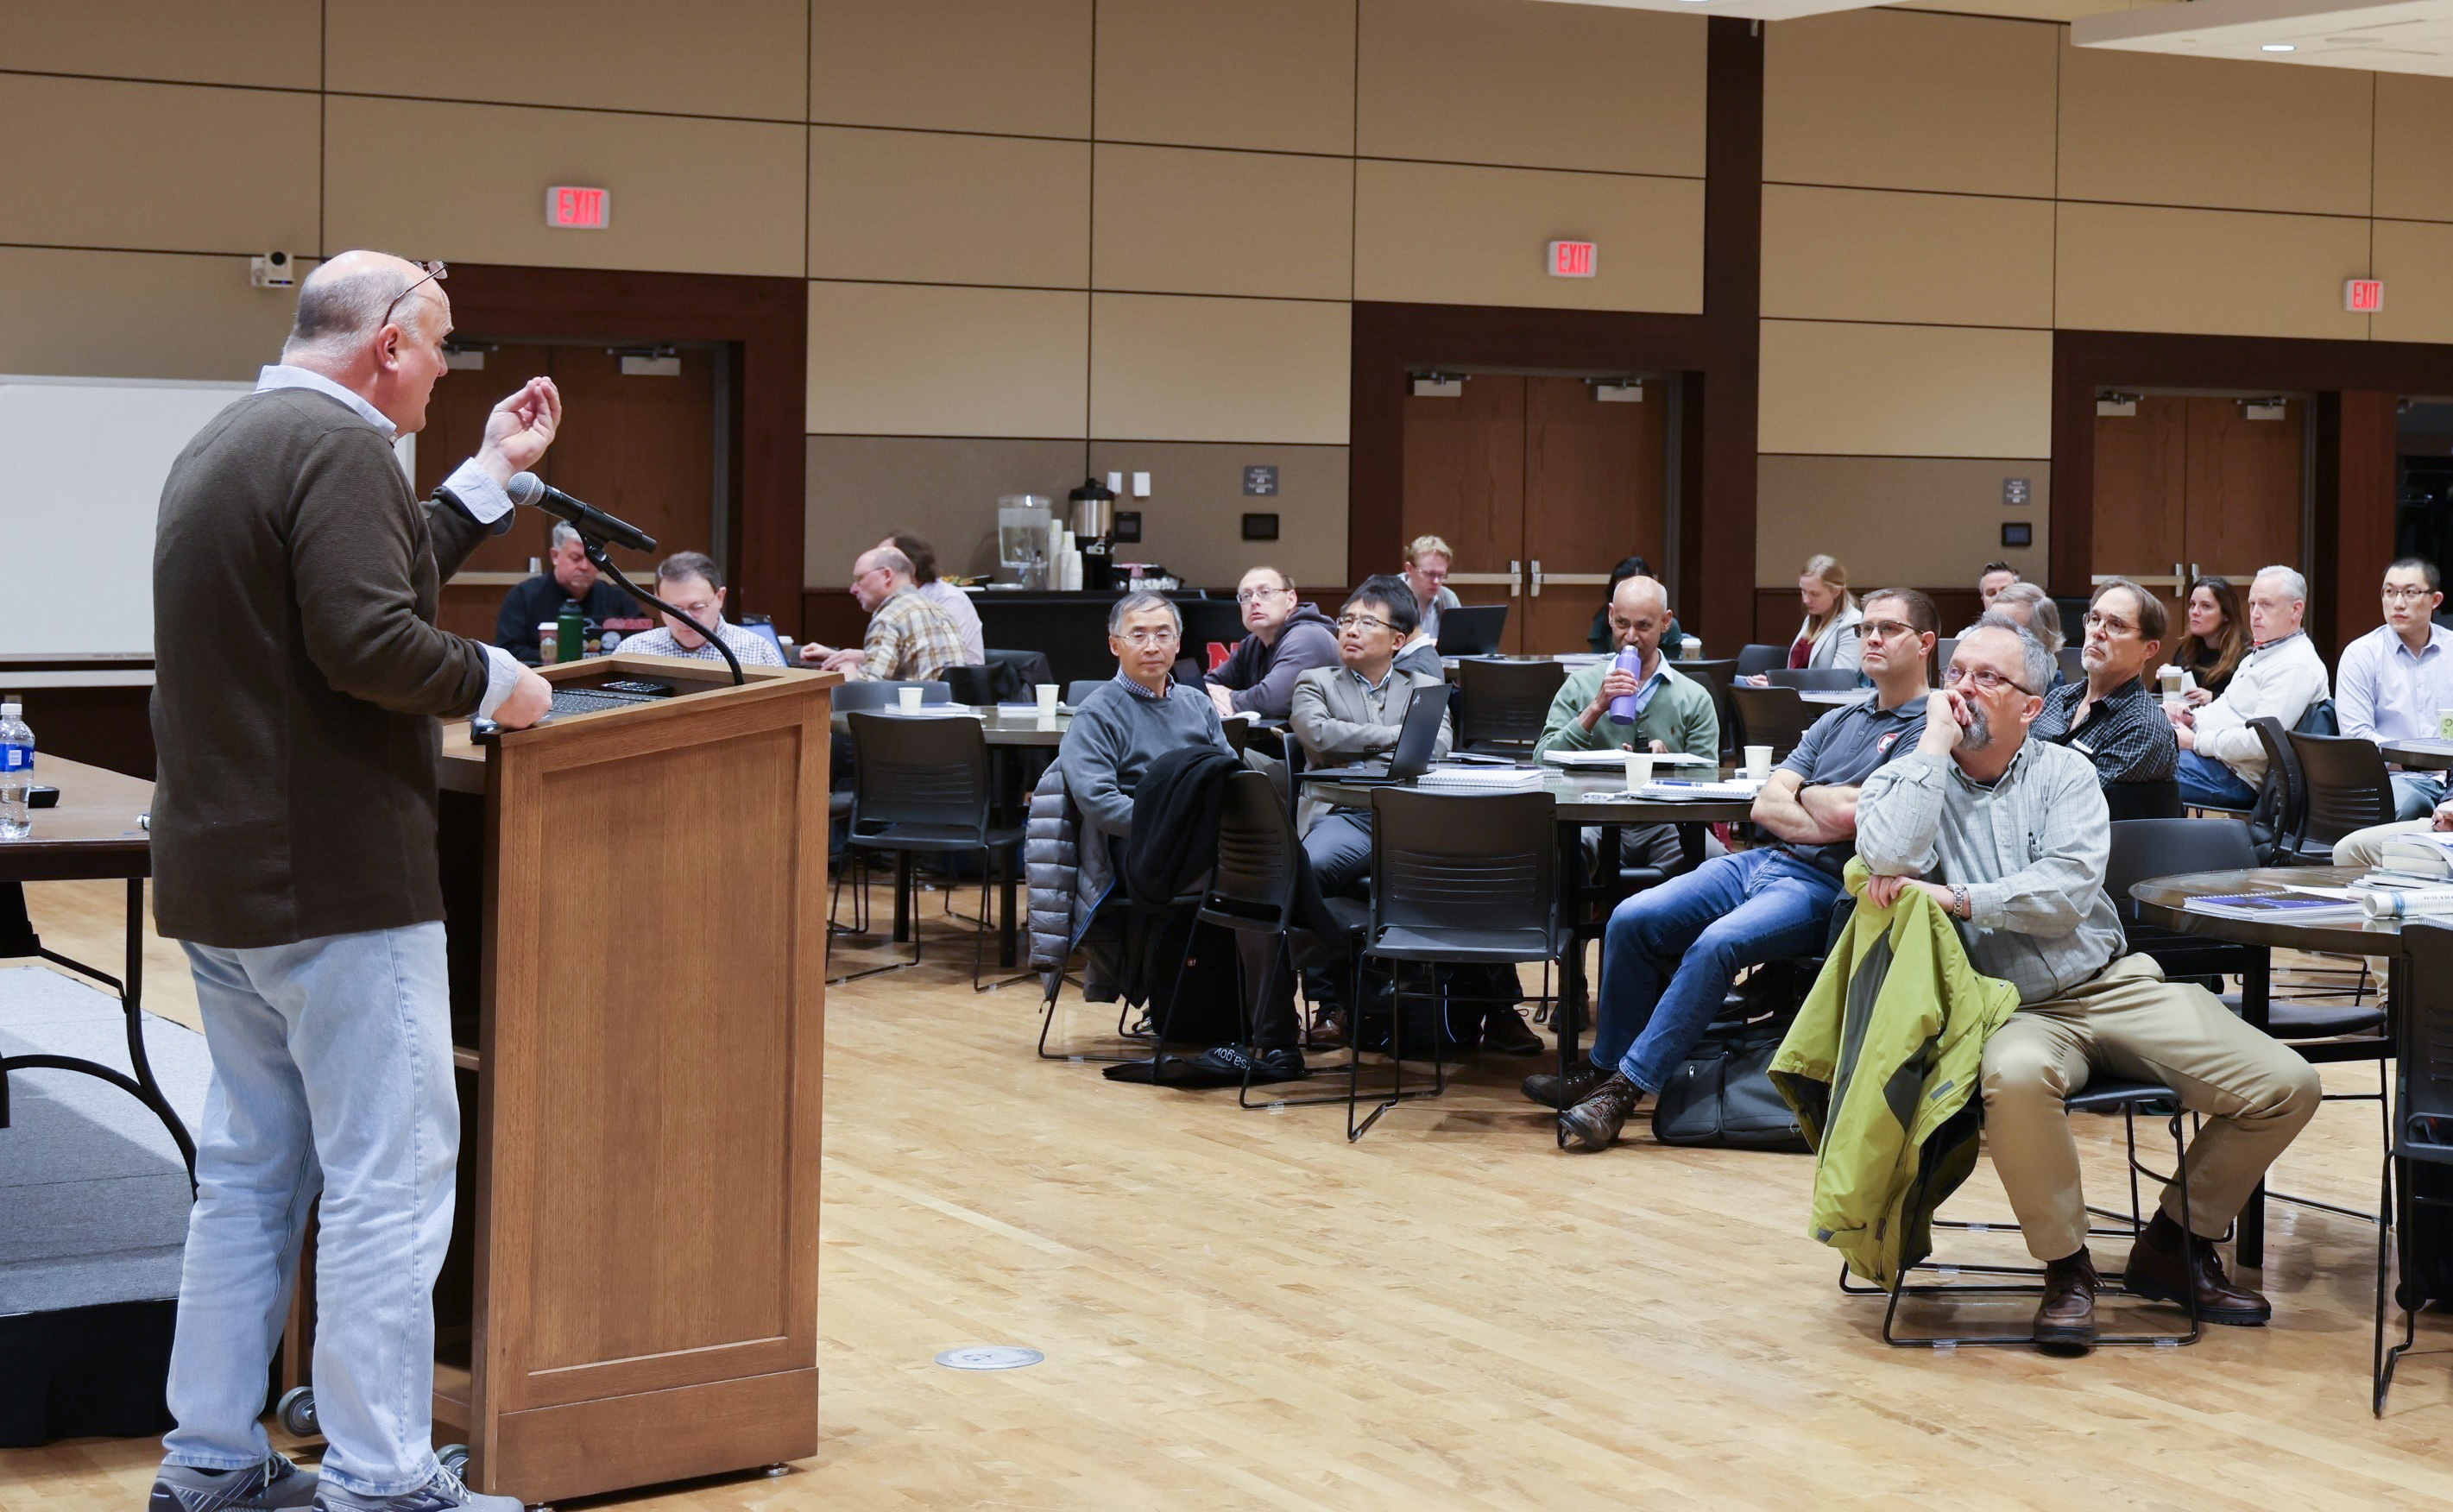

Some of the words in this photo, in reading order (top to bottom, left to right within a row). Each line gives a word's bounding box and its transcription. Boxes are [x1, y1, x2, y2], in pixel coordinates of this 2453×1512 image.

[558, 189, 602, 224] EXIT
[1558, 243, 1592, 274] EXIT
[2354, 281, 2380, 309] EXIT
[1214, 1047, 1251, 1070] sa.gov
